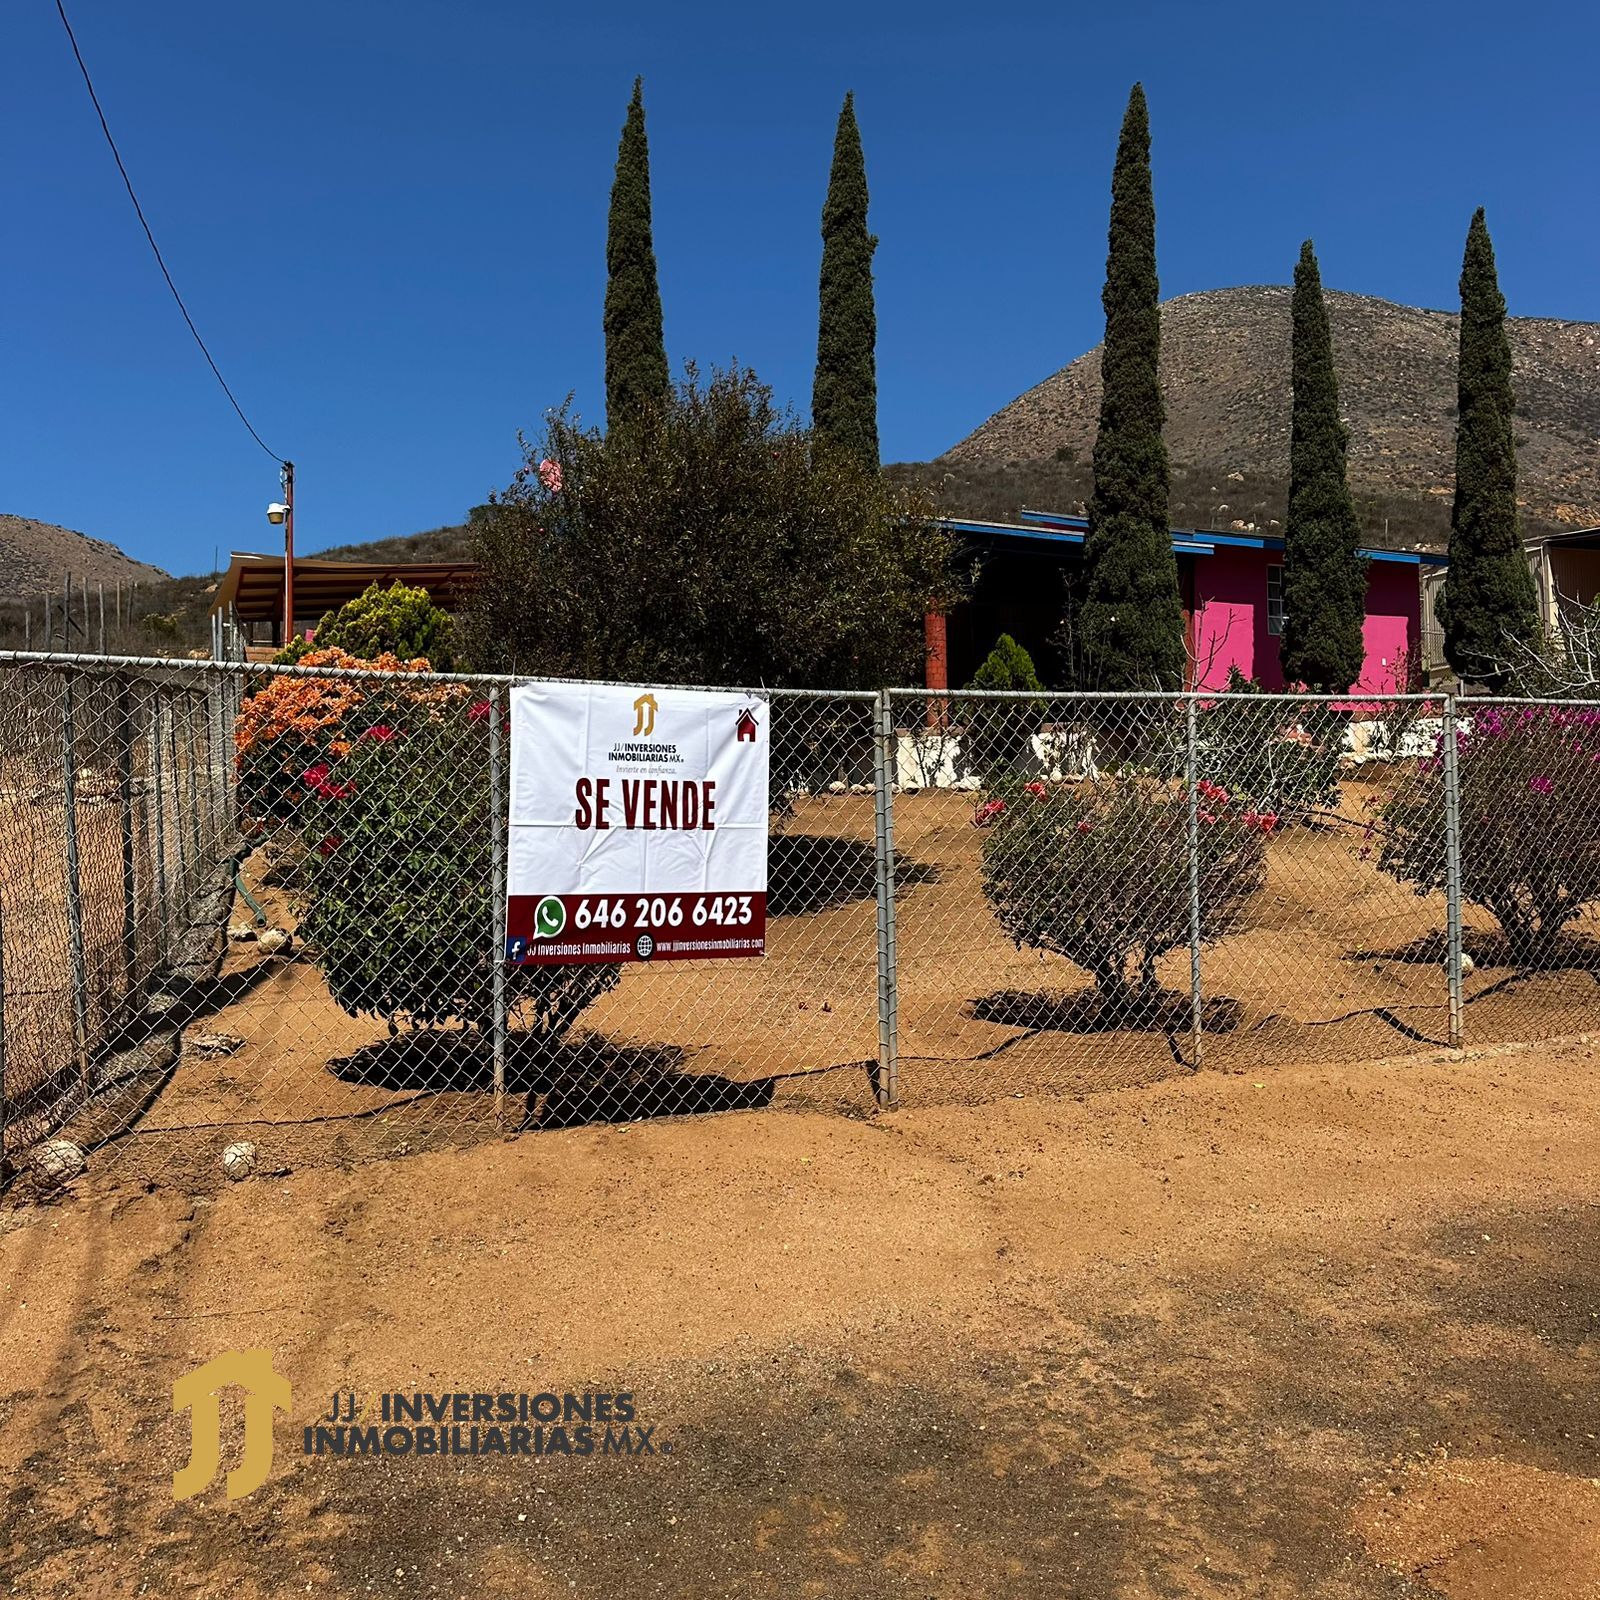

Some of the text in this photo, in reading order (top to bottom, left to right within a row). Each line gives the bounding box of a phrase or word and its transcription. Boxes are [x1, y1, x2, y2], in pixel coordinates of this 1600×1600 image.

[608, 752, 668, 763] INMOBILIARIAS
[575, 778, 716, 830] SE VENDE
[575, 896, 752, 929] 646 206 6423
[537, 941, 581, 956] Inversiones
[582, 940, 631, 955] Inmobiliarias
